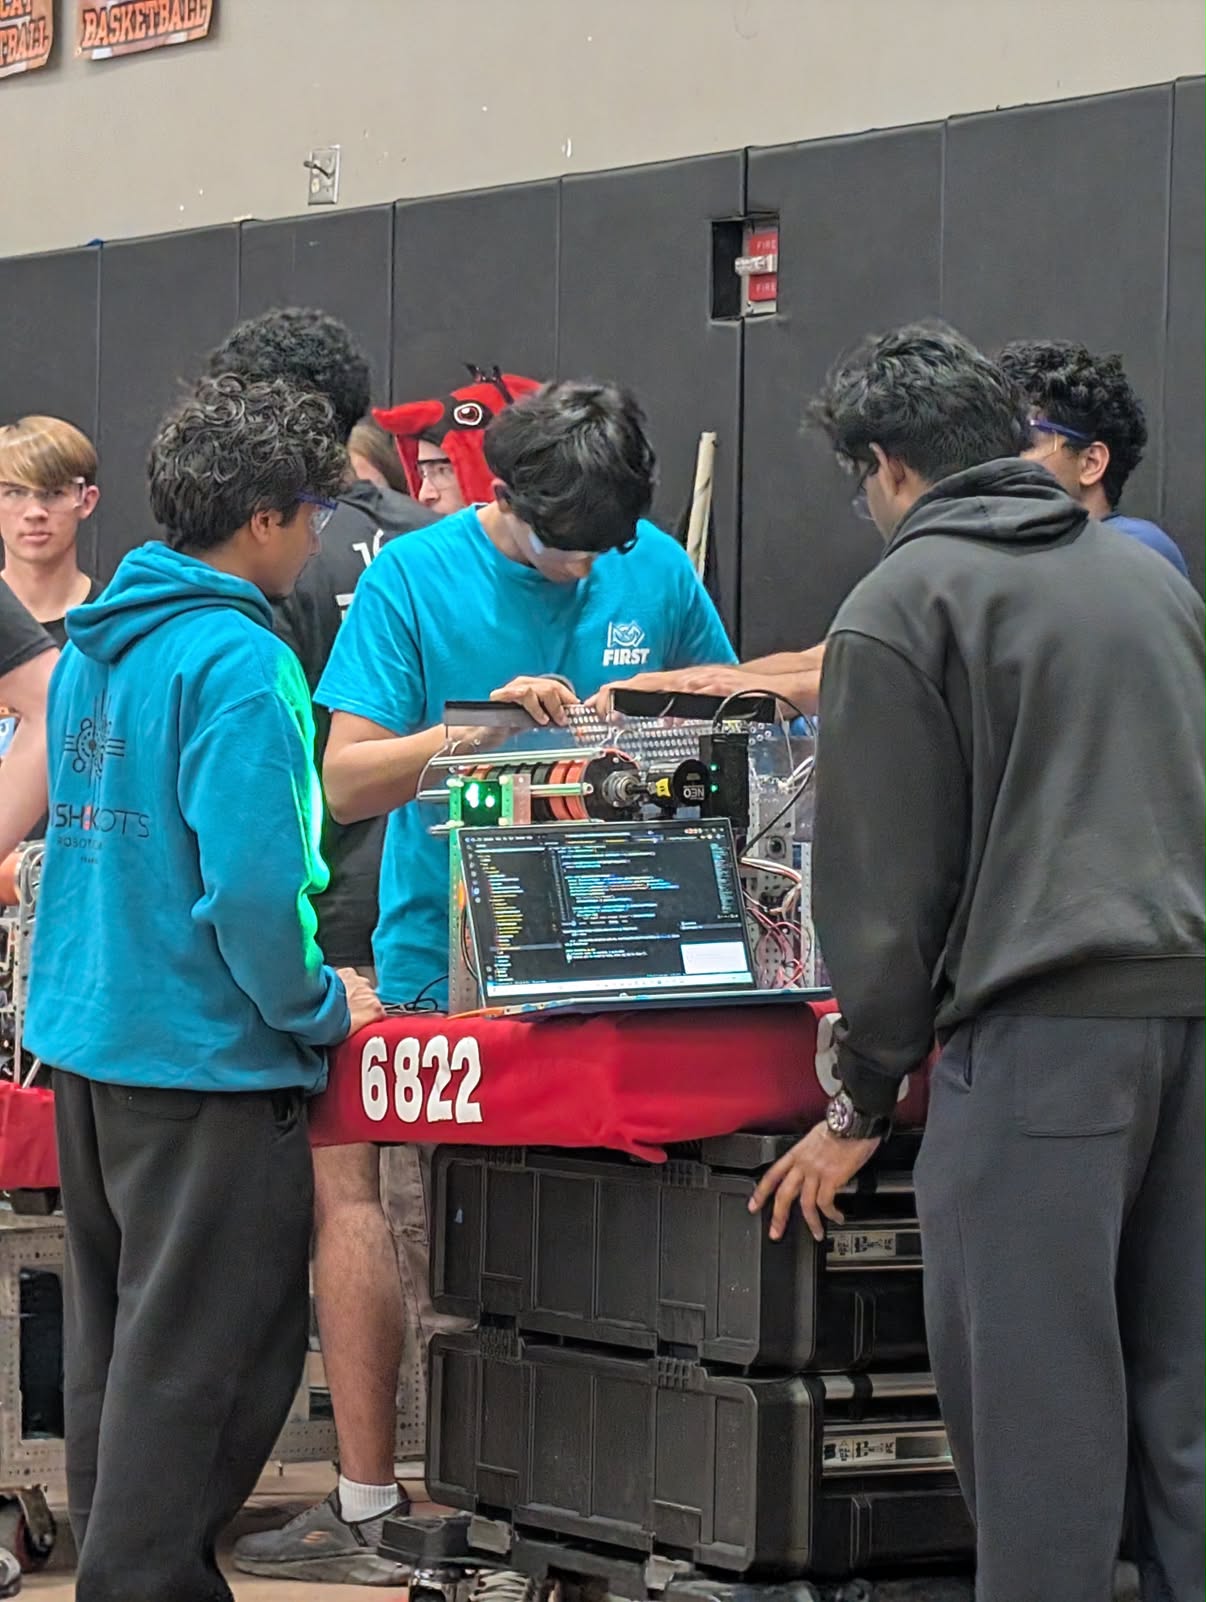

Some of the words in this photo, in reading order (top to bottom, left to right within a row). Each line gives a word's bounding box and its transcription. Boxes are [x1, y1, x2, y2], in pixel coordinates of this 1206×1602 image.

[81, 0, 207, 47] BASKETBALL
[756, 240, 777, 250] FIRE
[756, 282, 776, 292] FIRE
[603, 648, 650, 667] FIRST
[683, 788, 705, 799] NEO
[361, 1034, 484, 1123] 6822
